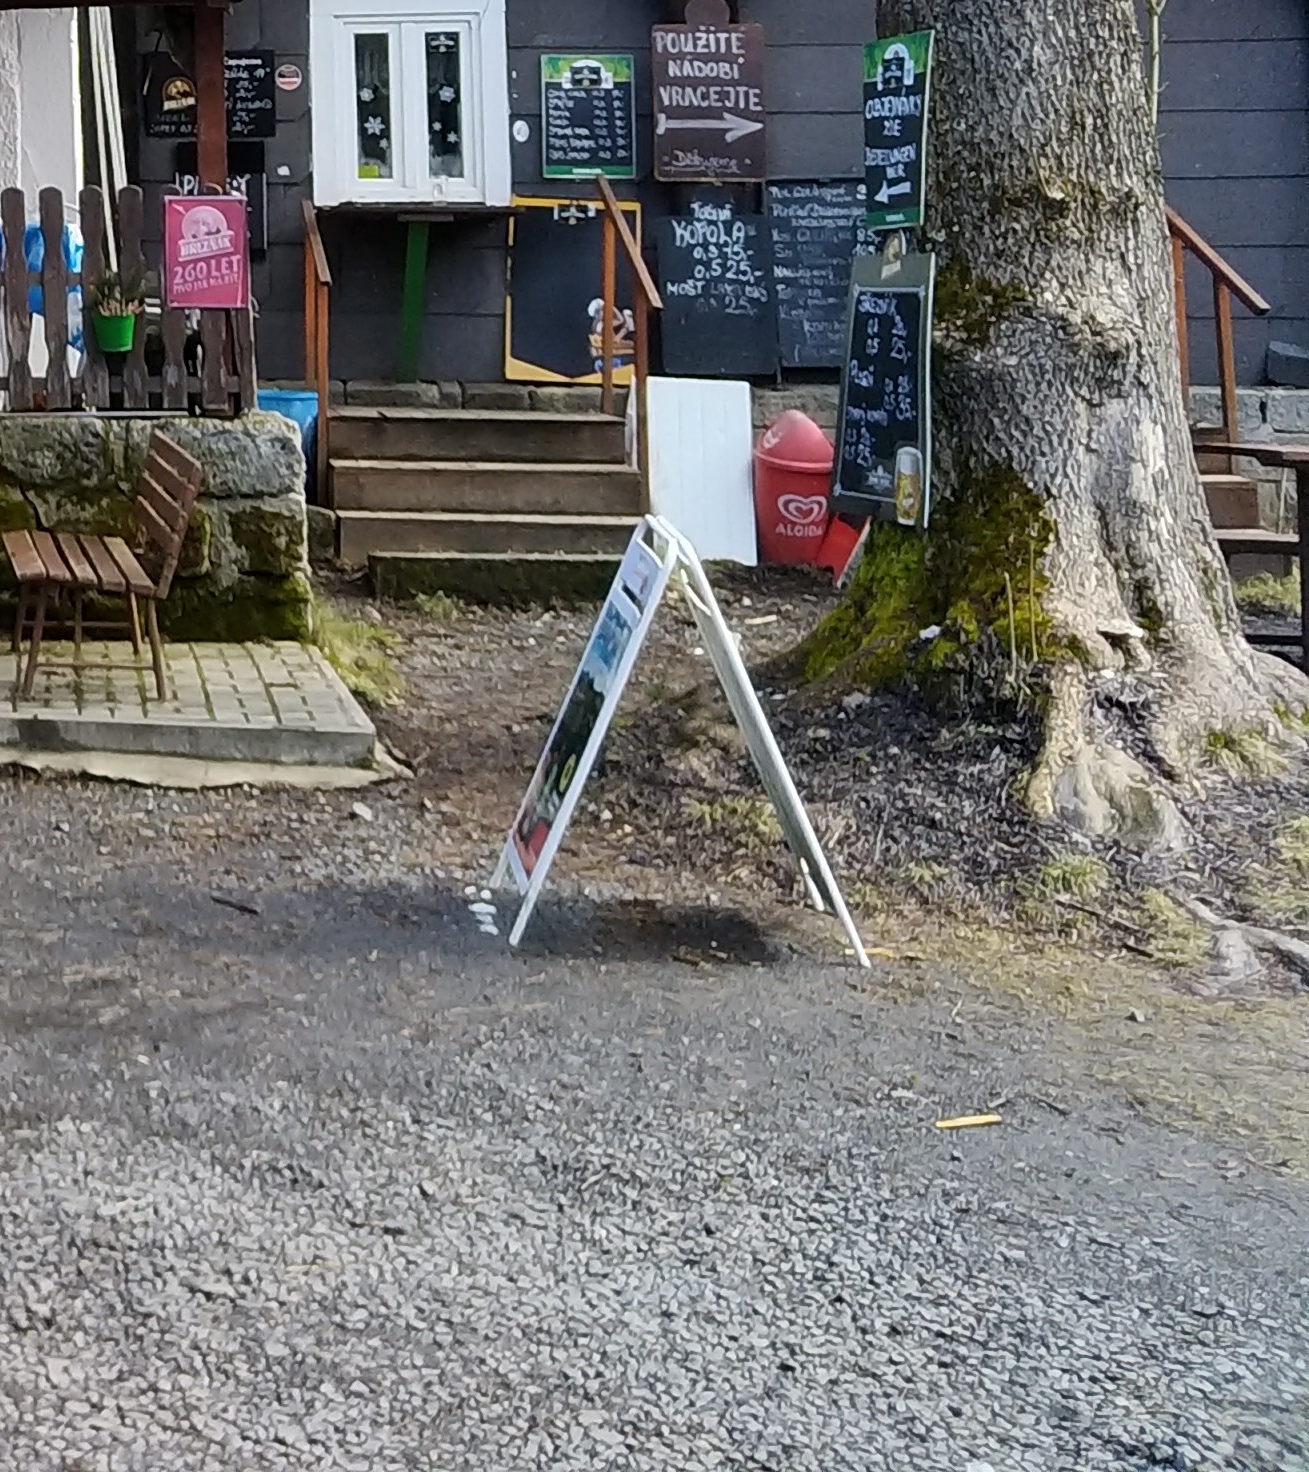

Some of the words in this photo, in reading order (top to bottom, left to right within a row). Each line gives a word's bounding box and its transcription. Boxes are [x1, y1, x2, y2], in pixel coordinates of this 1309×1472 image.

[659, 85, 763, 111] VRACEJTE
[671, 219, 745, 247] KOFOLA
[173, 260, 208, 284] 260
[210, 254, 241, 277] LET
